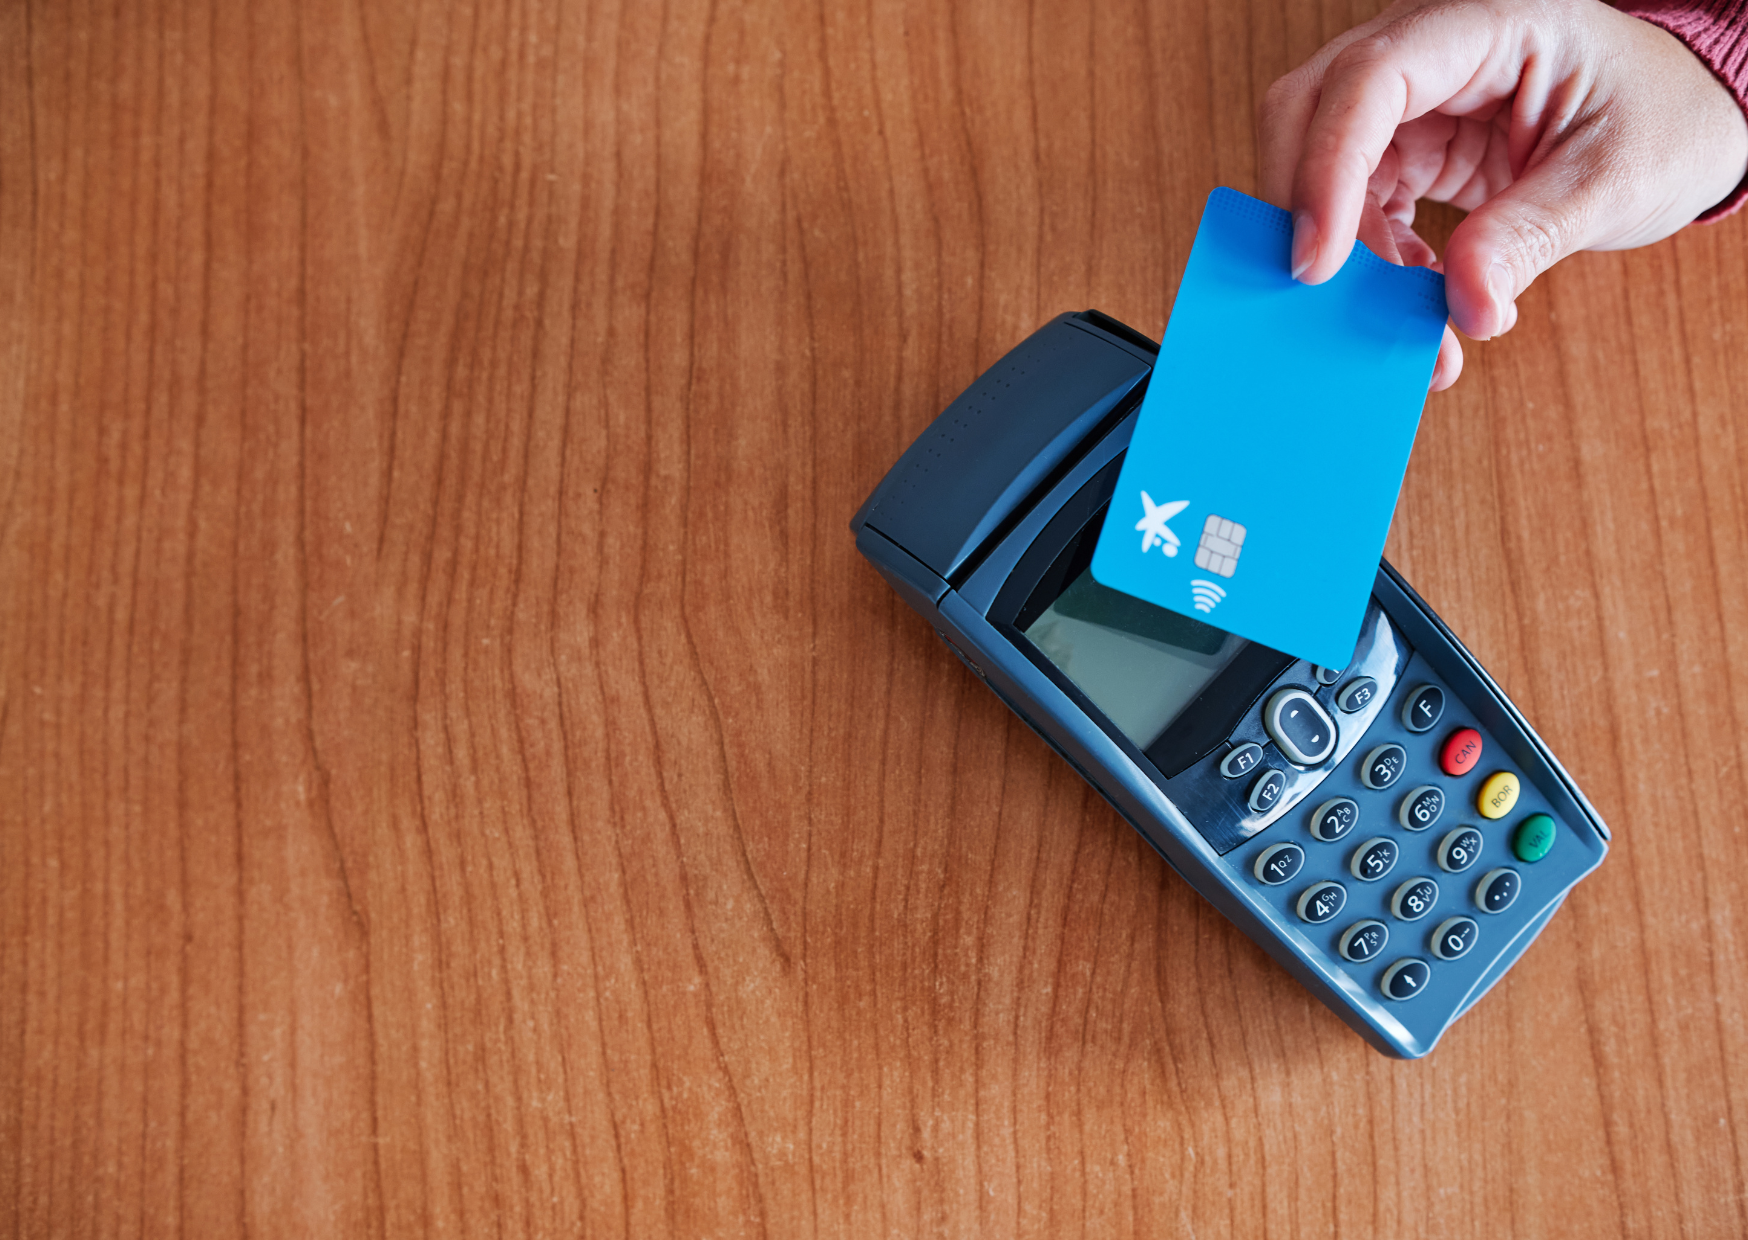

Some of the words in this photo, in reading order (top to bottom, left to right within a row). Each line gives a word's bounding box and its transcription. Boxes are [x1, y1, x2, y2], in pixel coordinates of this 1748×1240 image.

[1354, 688, 1371, 704] F3
[1419, 699, 1432, 718] F
[1237, 752, 1254, 770] F1
[1455, 740, 1477, 764] CAN
[1262, 783, 1280, 801] F2
[1491, 785, 1513, 808] BOR
[1529, 830, 1550, 849] VAL
